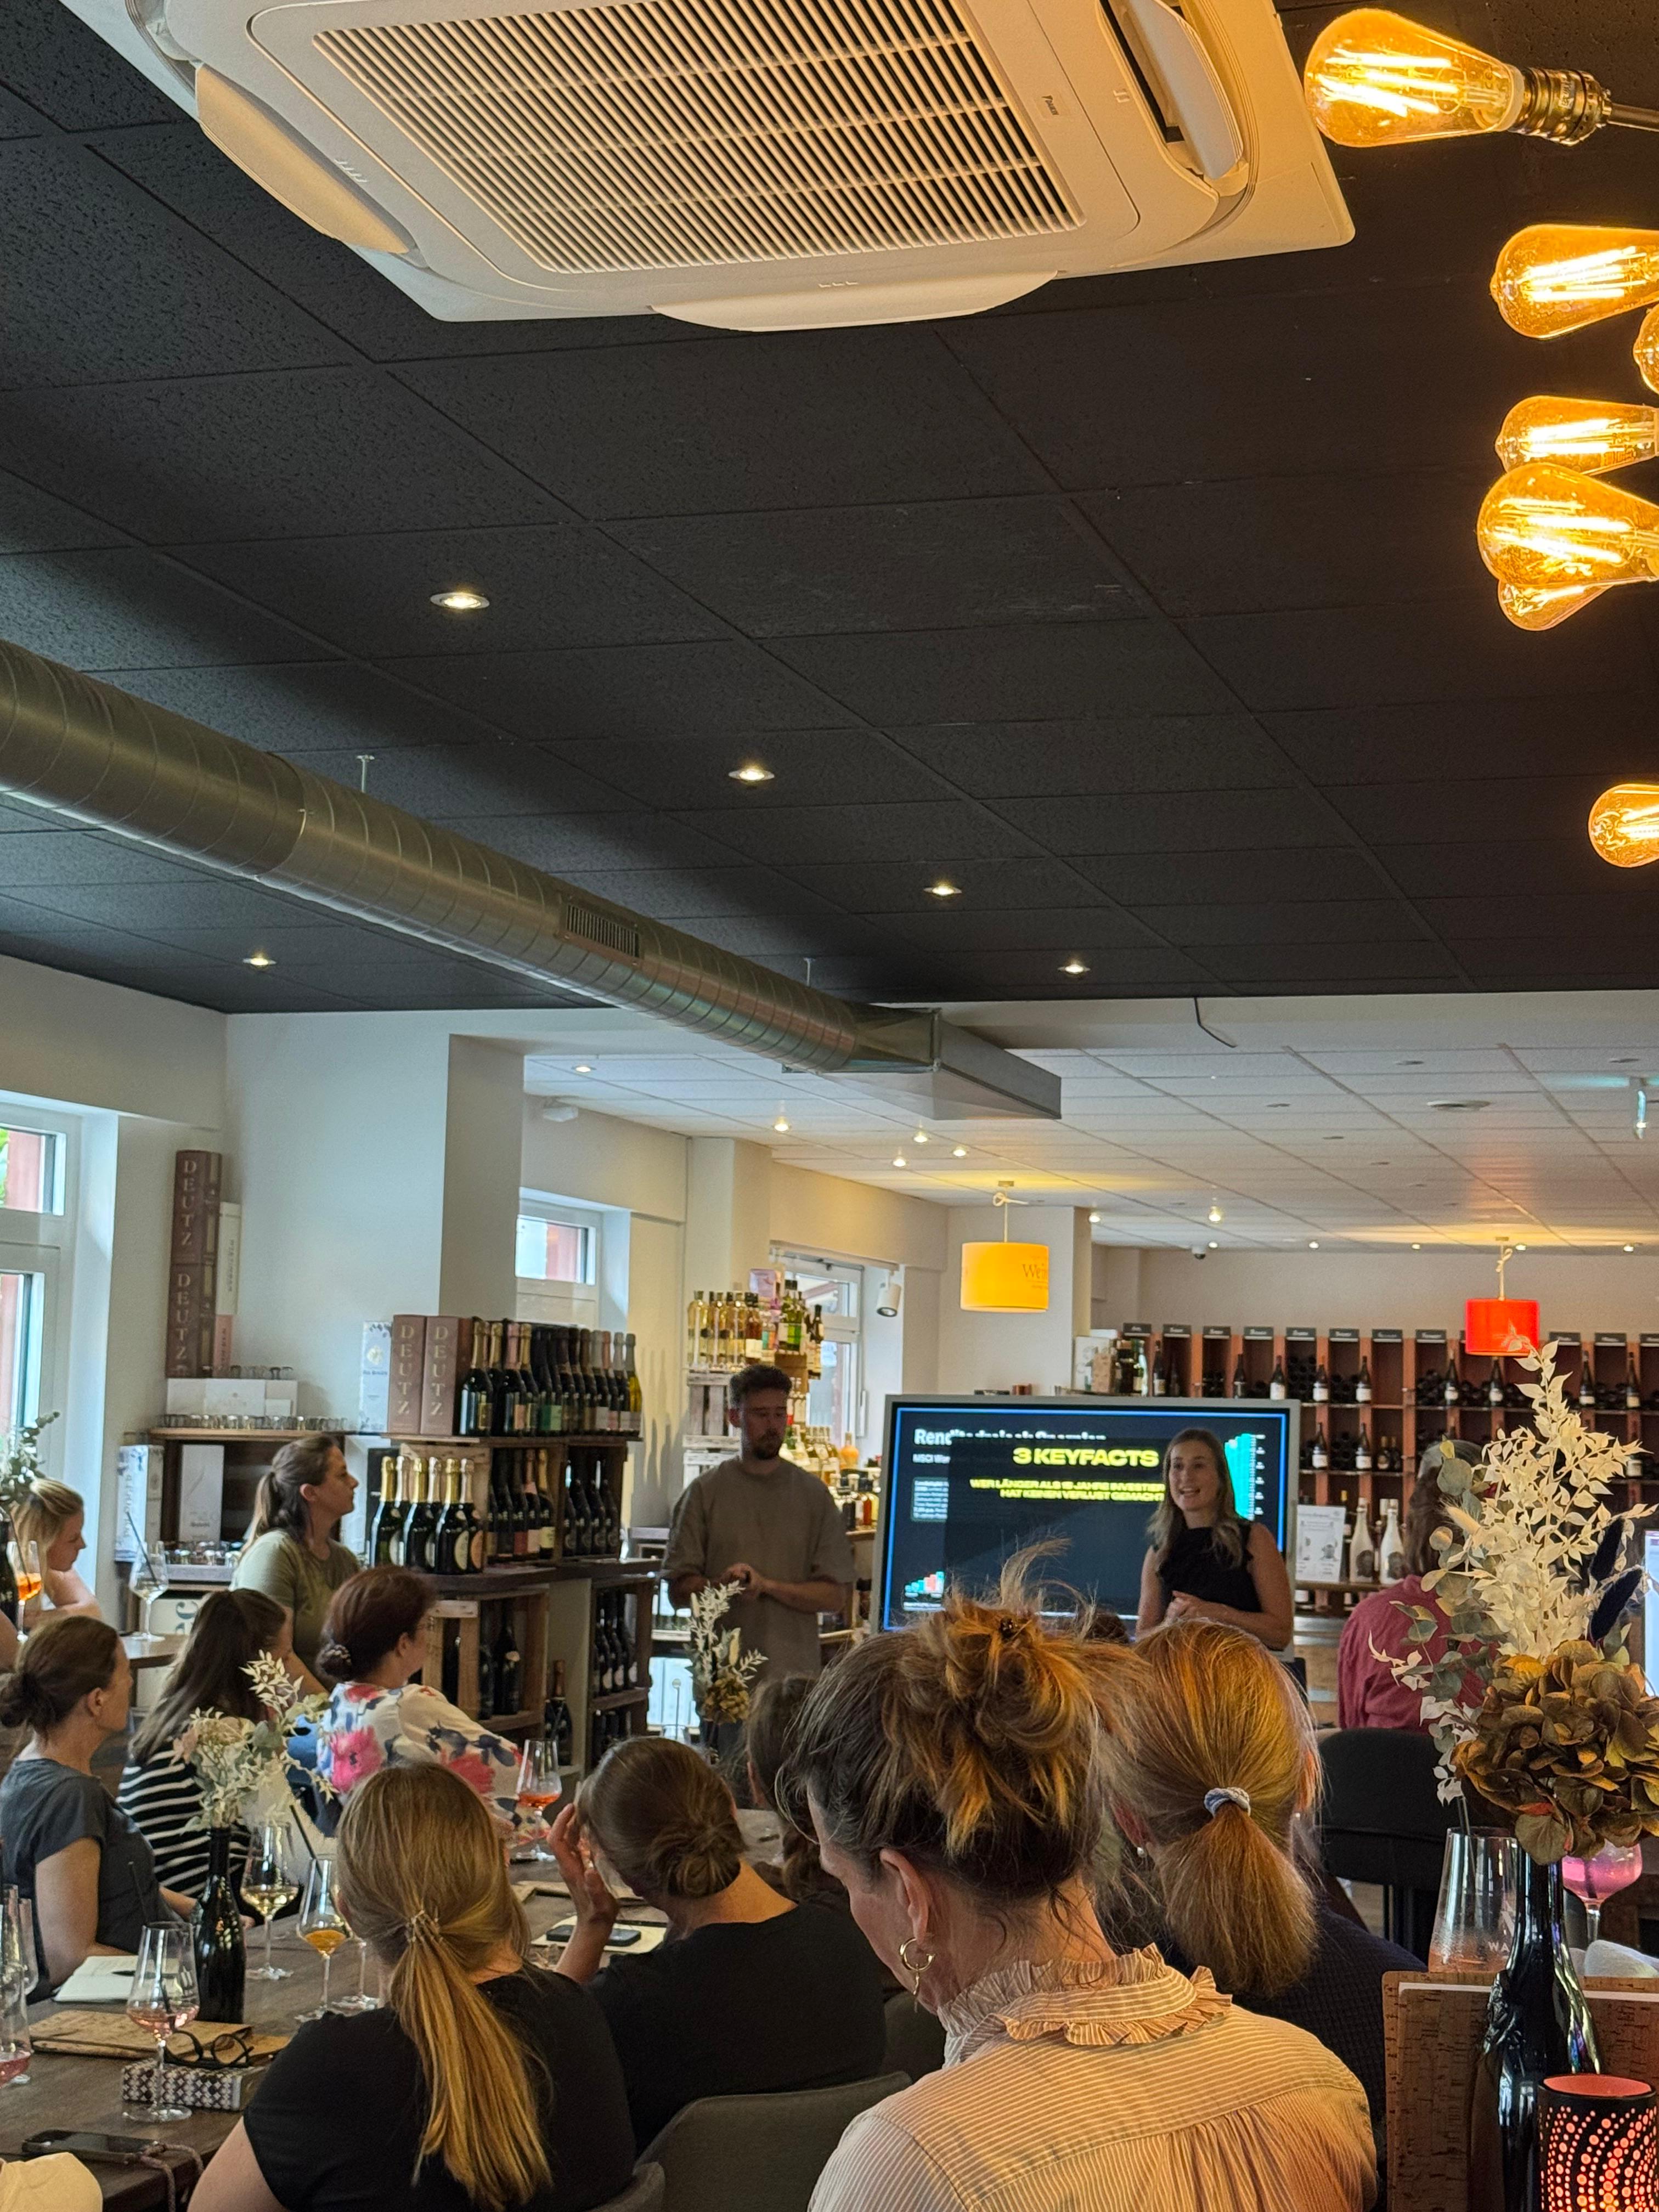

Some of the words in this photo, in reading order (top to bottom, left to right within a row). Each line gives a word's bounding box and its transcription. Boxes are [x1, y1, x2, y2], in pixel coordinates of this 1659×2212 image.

[183, 1160, 197, 1245] DEUTZ
[177, 1274, 191, 1360] DEUTZ
[398, 1324, 415, 1415] DEUTZ
[430, 1326, 449, 1416] DEUTZ
[1013, 1447, 1031, 1465] 3
[1034, 1448, 1160, 1468] KEYFACTS
[1488, 1940, 1510, 1953] WA
